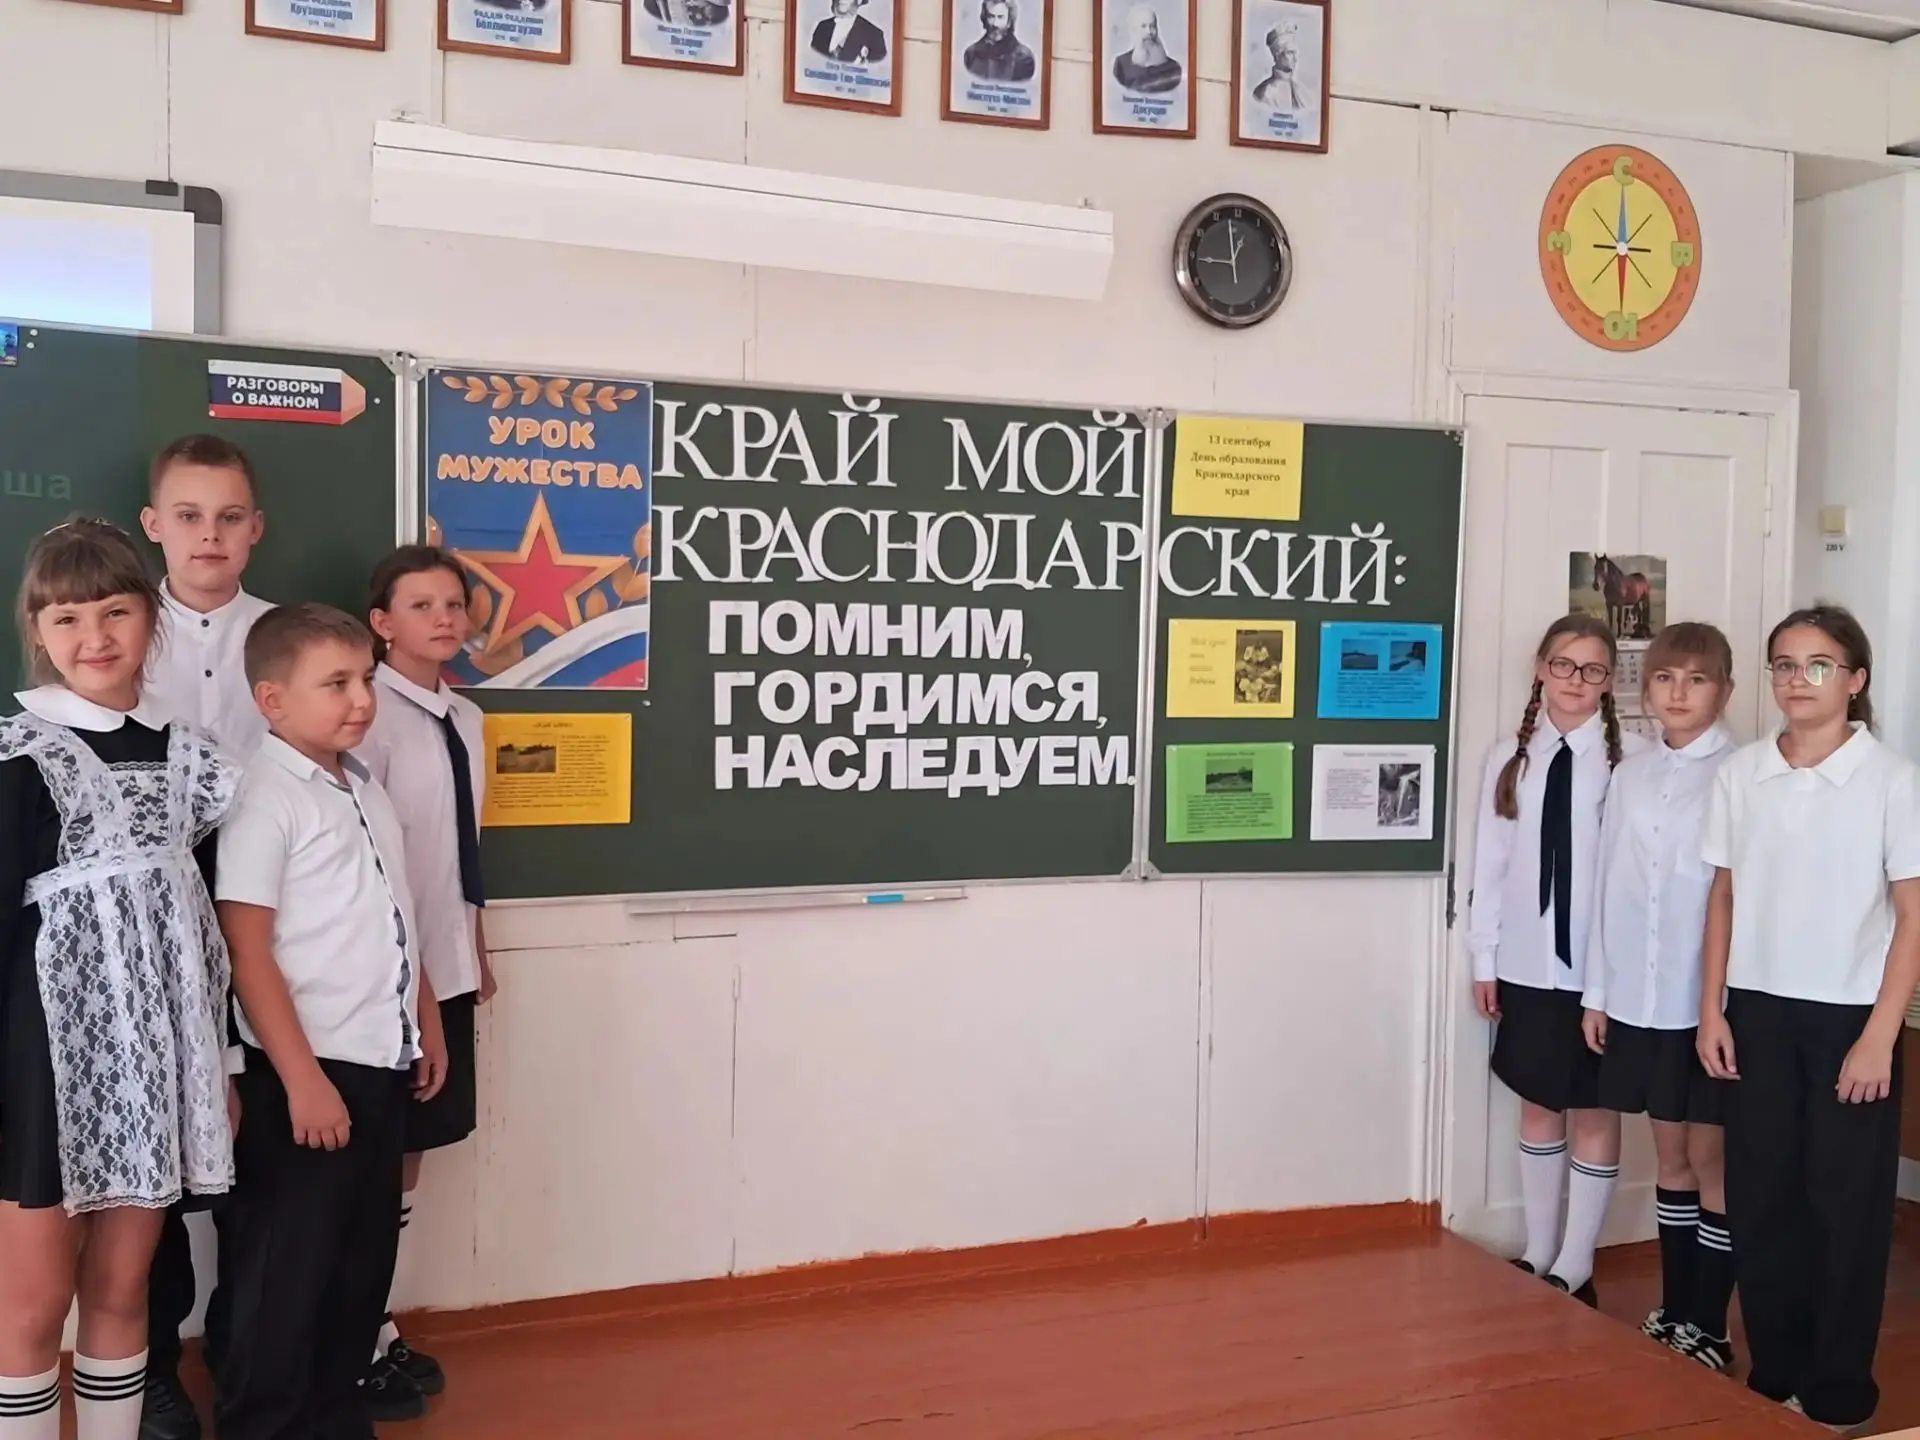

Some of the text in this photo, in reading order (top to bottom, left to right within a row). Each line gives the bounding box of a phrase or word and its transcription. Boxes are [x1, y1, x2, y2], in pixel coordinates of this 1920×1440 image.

[226, 376, 325, 395] РАЗГОВОРЫ
[231, 392, 320, 409] О ВАЖНОМ
[488, 415, 596, 450] УРОК
[653, 392, 1143, 498] КРАЙ МОЙ
[1208, 435, 1272, 449] 13 сентября
[437, 453, 643, 490] МУЖЕСТВА
[1190, 452, 1287, 466] День образования
[1195, 468, 1281, 482] Краснодарского
[1224, 488, 1251, 498] края
[708, 599, 1033, 668] ПОМНИМ,
[714, 669, 1108, 735] ГОРДИМСЯ,
[714, 734, 1137, 799] НАСЛЕДУЕМ.
